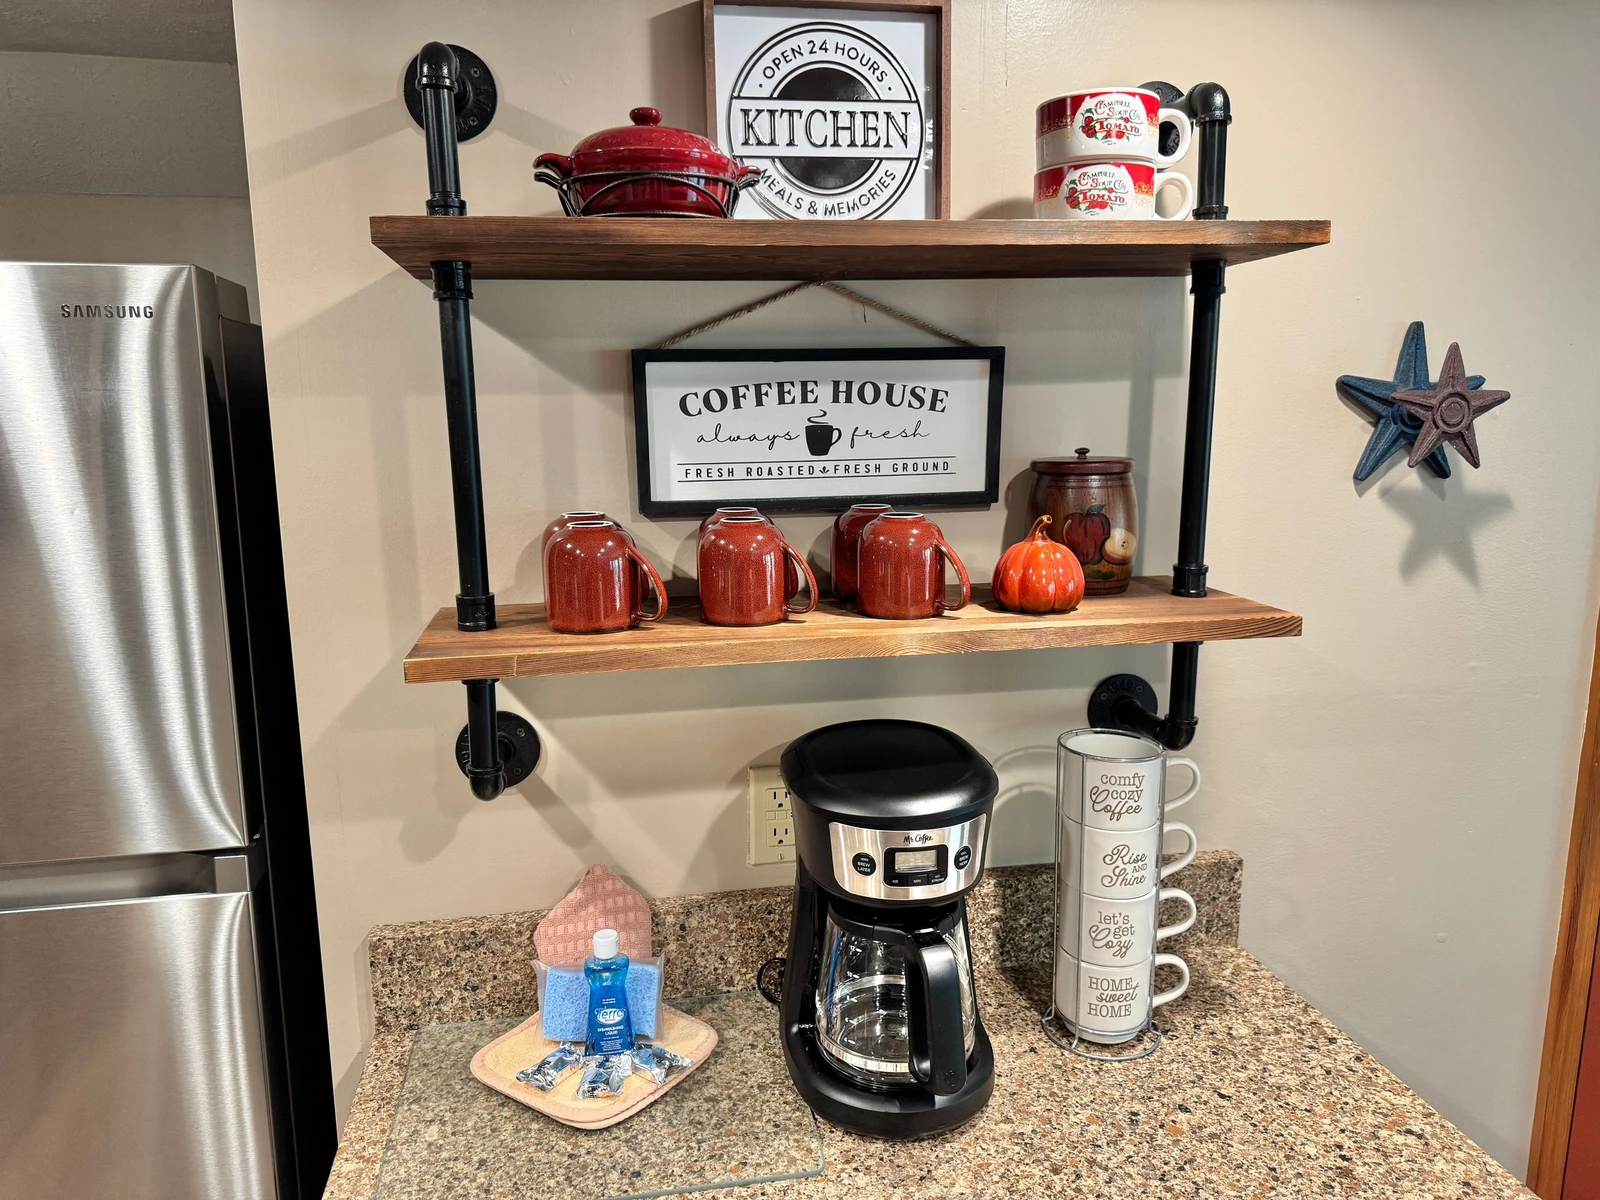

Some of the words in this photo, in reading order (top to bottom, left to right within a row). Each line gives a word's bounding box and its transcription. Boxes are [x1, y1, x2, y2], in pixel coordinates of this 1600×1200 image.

[762, 44, 804, 80] OPEN
[807, 39, 830, 55] 24
[835, 41, 888, 83] HOURS
[740, 108, 911, 149] KITCHEN
[759, 168, 804, 211] MEALS
[807, 200, 818, 215] &
[824, 169, 897, 217] MEMORIES
[61, 304, 154, 319] SAMSUNG
[678, 380, 819, 417] COFFEE
[830, 379, 950, 413] HOUSE
[696, 423, 800, 451] always
[850, 419, 930, 449] fresh
[685, 466, 735, 479] FRESH
[746, 464, 816, 477] ROASTED
[833, 463, 882, 475] FRESH
[892, 461, 950, 473] GROUND
[1100, 772, 1145, 788] comfy
[1089, 785, 1143, 822] Coffee
[1110, 789, 1144, 803] cozy
[915, 833, 933, 845] Coffee
[1102, 844, 1148, 865] Rise
[1100, 865, 1146, 888] Shine
[1131, 864, 1148, 874] AND
[1098, 911, 1130, 925] let's
[1089, 924, 1134, 958] Cozy
[1112, 924, 1135, 939] get
[1087, 976, 1133, 991] HOME
[1096, 982, 1140, 1002] sweet
[1087, 1002, 1132, 1018] HOME
